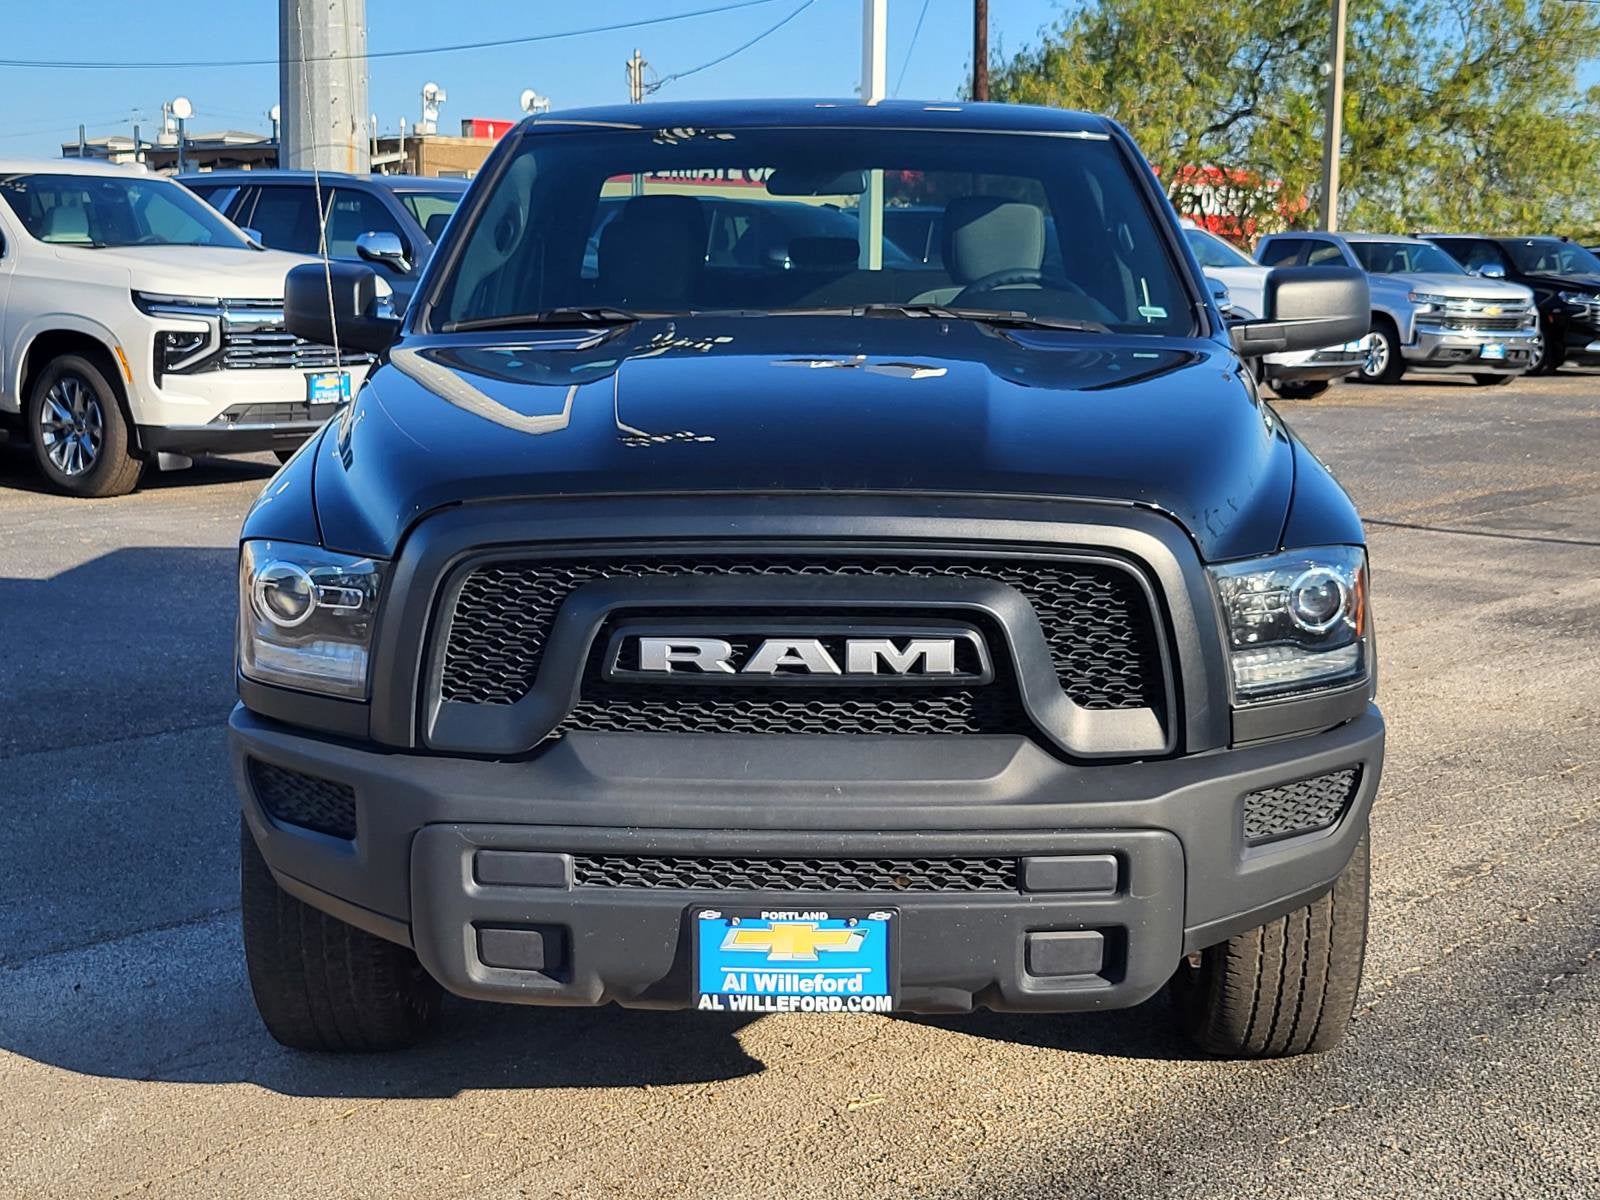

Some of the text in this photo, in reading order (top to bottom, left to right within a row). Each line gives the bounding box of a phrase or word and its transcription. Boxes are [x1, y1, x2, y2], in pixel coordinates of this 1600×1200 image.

[639, 637, 955, 675] RAM
[761, 911, 828, 921] PORTLAND
[722, 973, 863, 992] Al Willeford
[698, 994, 892, 1012] AL WILLEFORD.COM
